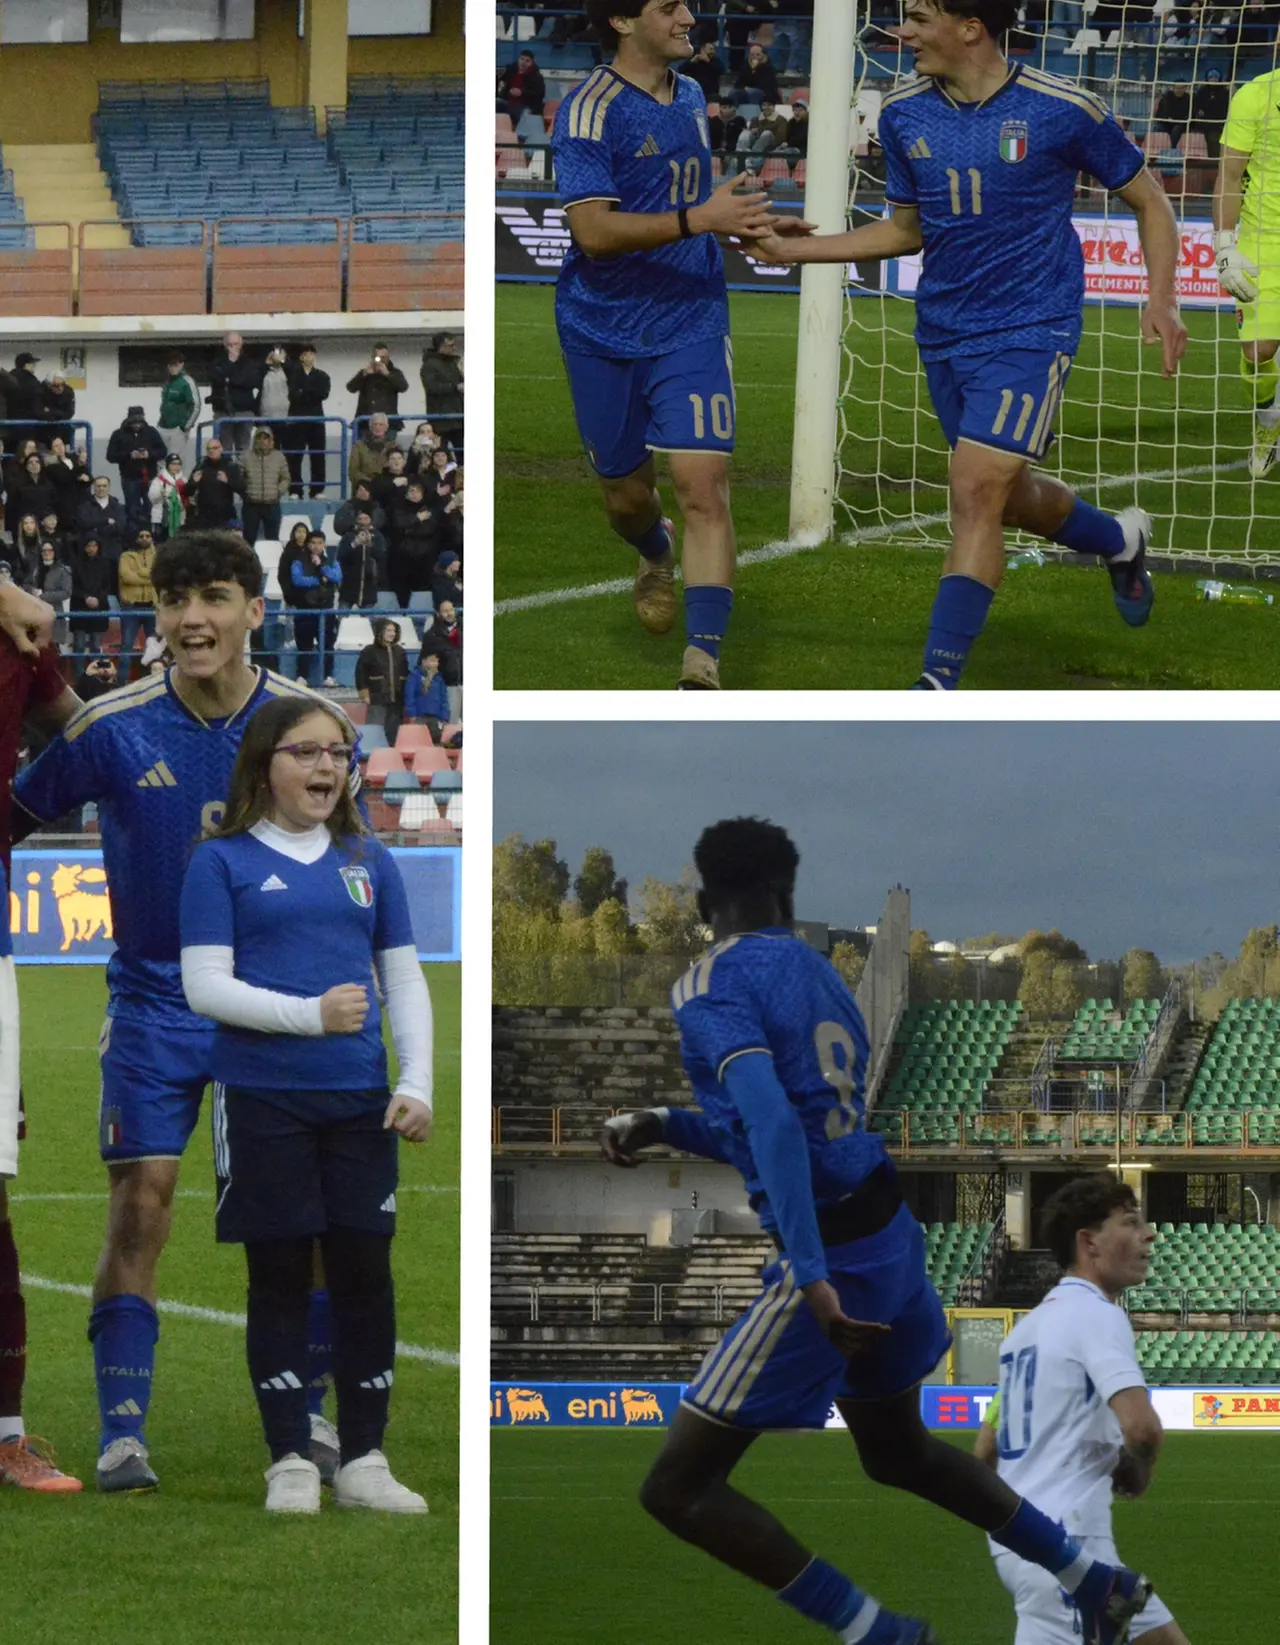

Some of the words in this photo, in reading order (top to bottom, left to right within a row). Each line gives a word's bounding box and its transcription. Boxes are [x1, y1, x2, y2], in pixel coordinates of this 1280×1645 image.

[1002, 129, 1027, 138] ITALIA
[669, 156, 700, 205] 10
[946, 168, 981, 215] 11
[1086, 276, 1149, 292] ICEMENTE
[689, 394, 732, 439] 10
[992, 389, 1034, 441] 11
[931, 648, 965, 661] ITALI
[567, 1391, 616, 1419] eni
